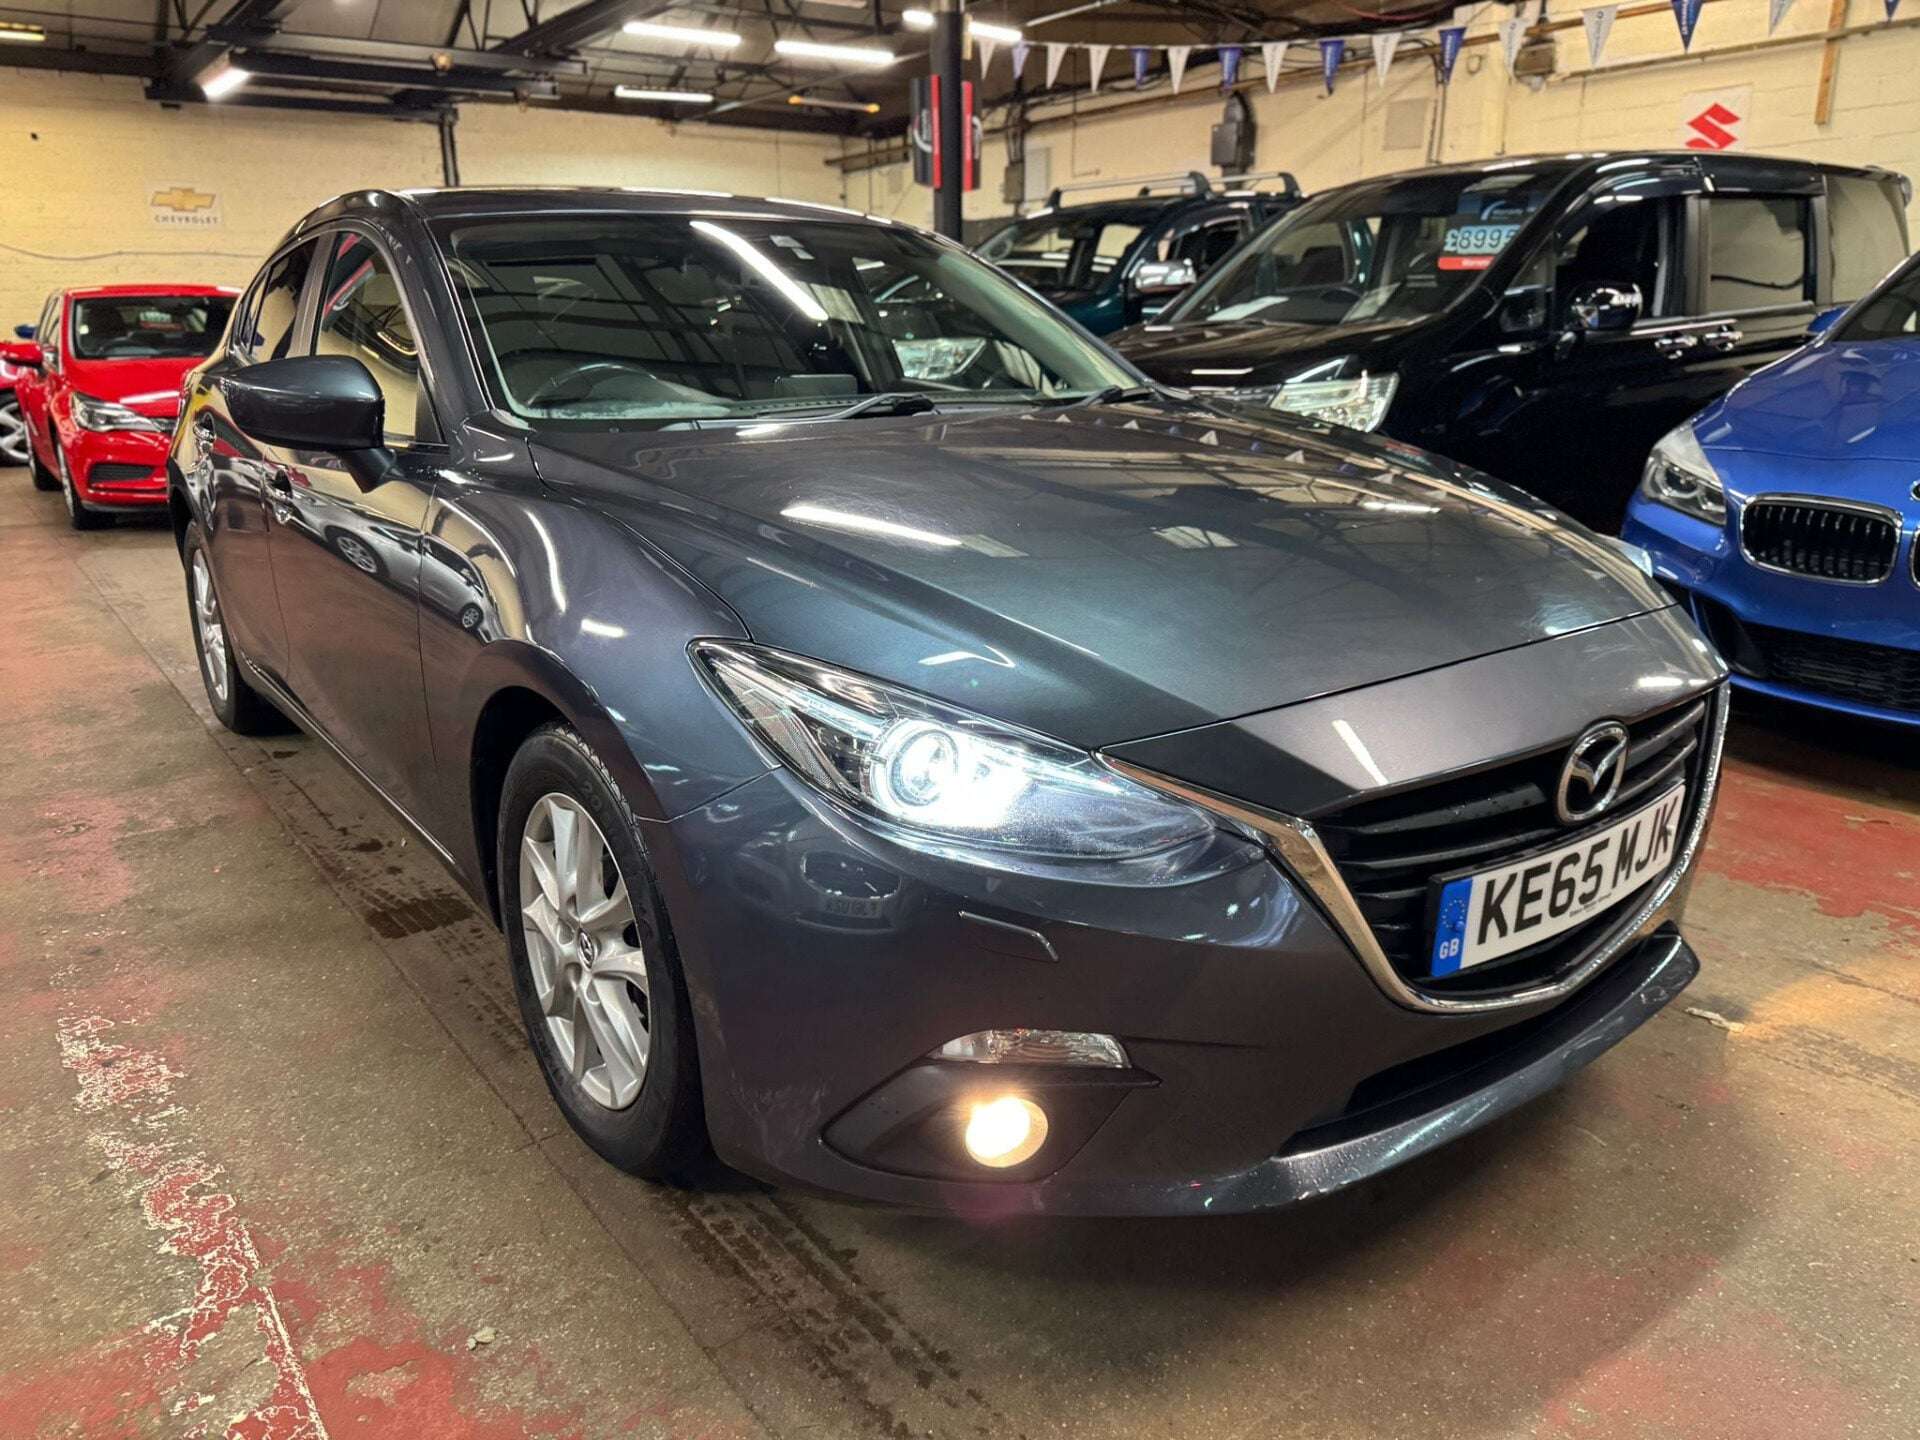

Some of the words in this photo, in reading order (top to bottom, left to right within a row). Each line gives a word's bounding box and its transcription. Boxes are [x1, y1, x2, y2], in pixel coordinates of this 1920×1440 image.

[154, 215, 218, 224] CHEVROLET
[1477, 837, 1610, 946] KE65
[1612, 795, 1678, 888] MJK
[1439, 937, 1460, 960] GB
